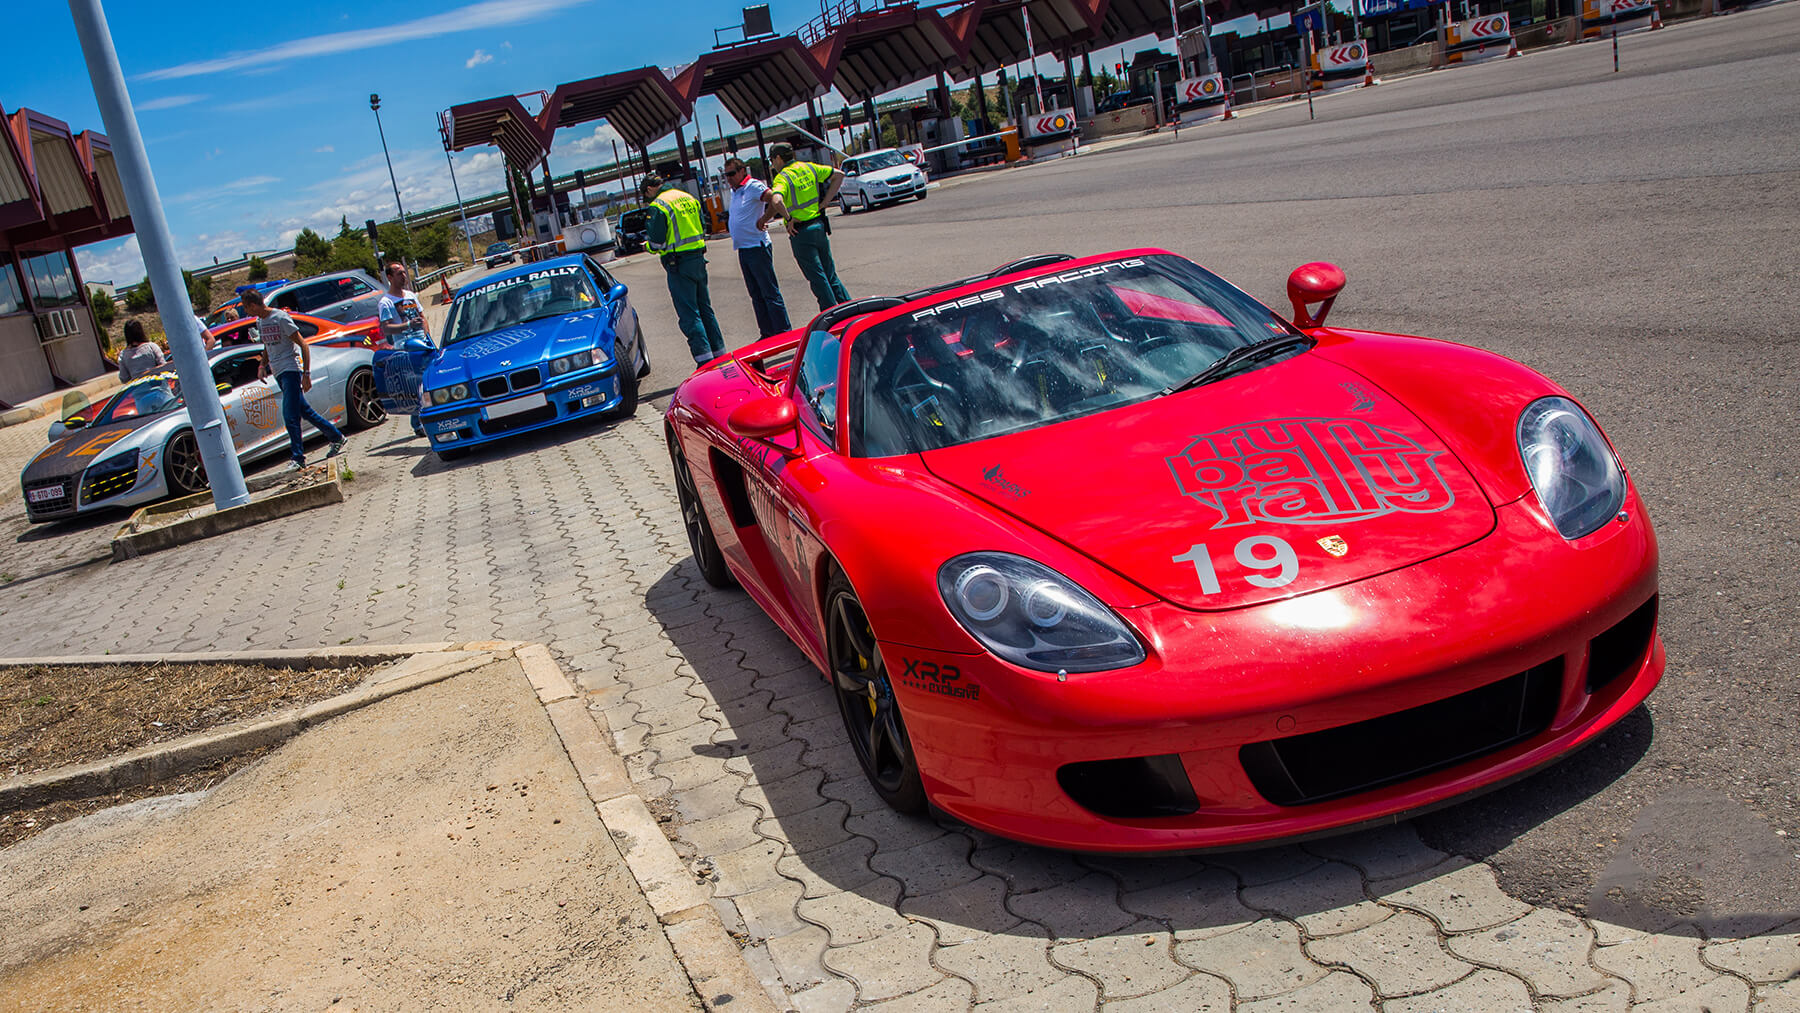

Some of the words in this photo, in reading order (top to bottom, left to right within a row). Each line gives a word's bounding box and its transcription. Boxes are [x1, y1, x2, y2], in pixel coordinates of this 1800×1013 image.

[529, 267, 578, 281] RALLY
[912, 289, 1005, 322] RAES
[1014, 258, 1145, 294] RACING
[66, 428, 133, 458] 12
[1172, 535, 1300, 596] 19
[902, 657, 961, 684] XRP
